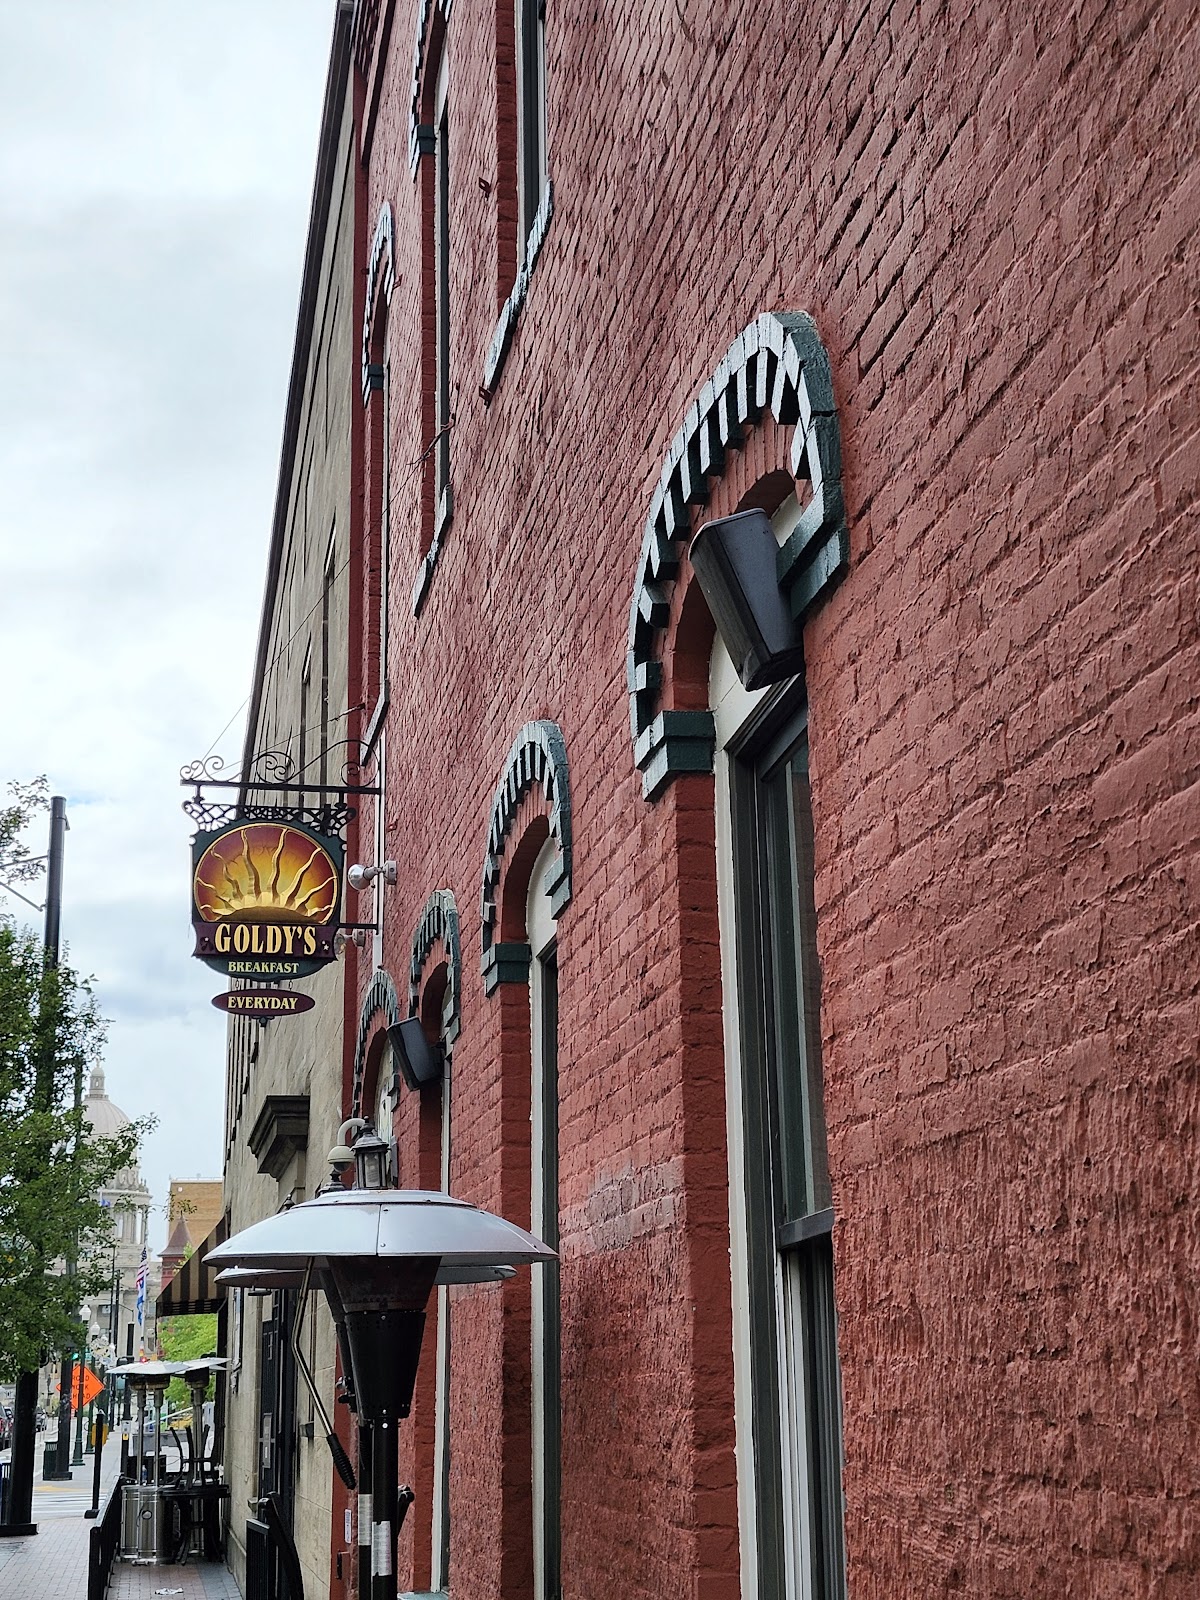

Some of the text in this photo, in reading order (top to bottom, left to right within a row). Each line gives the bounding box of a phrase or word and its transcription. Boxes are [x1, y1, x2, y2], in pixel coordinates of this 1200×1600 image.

[214, 923, 317, 955] GOLDY'S
[228, 961, 300, 974] BREAKFAST
[227, 996, 298, 1010] EVERYDAY
